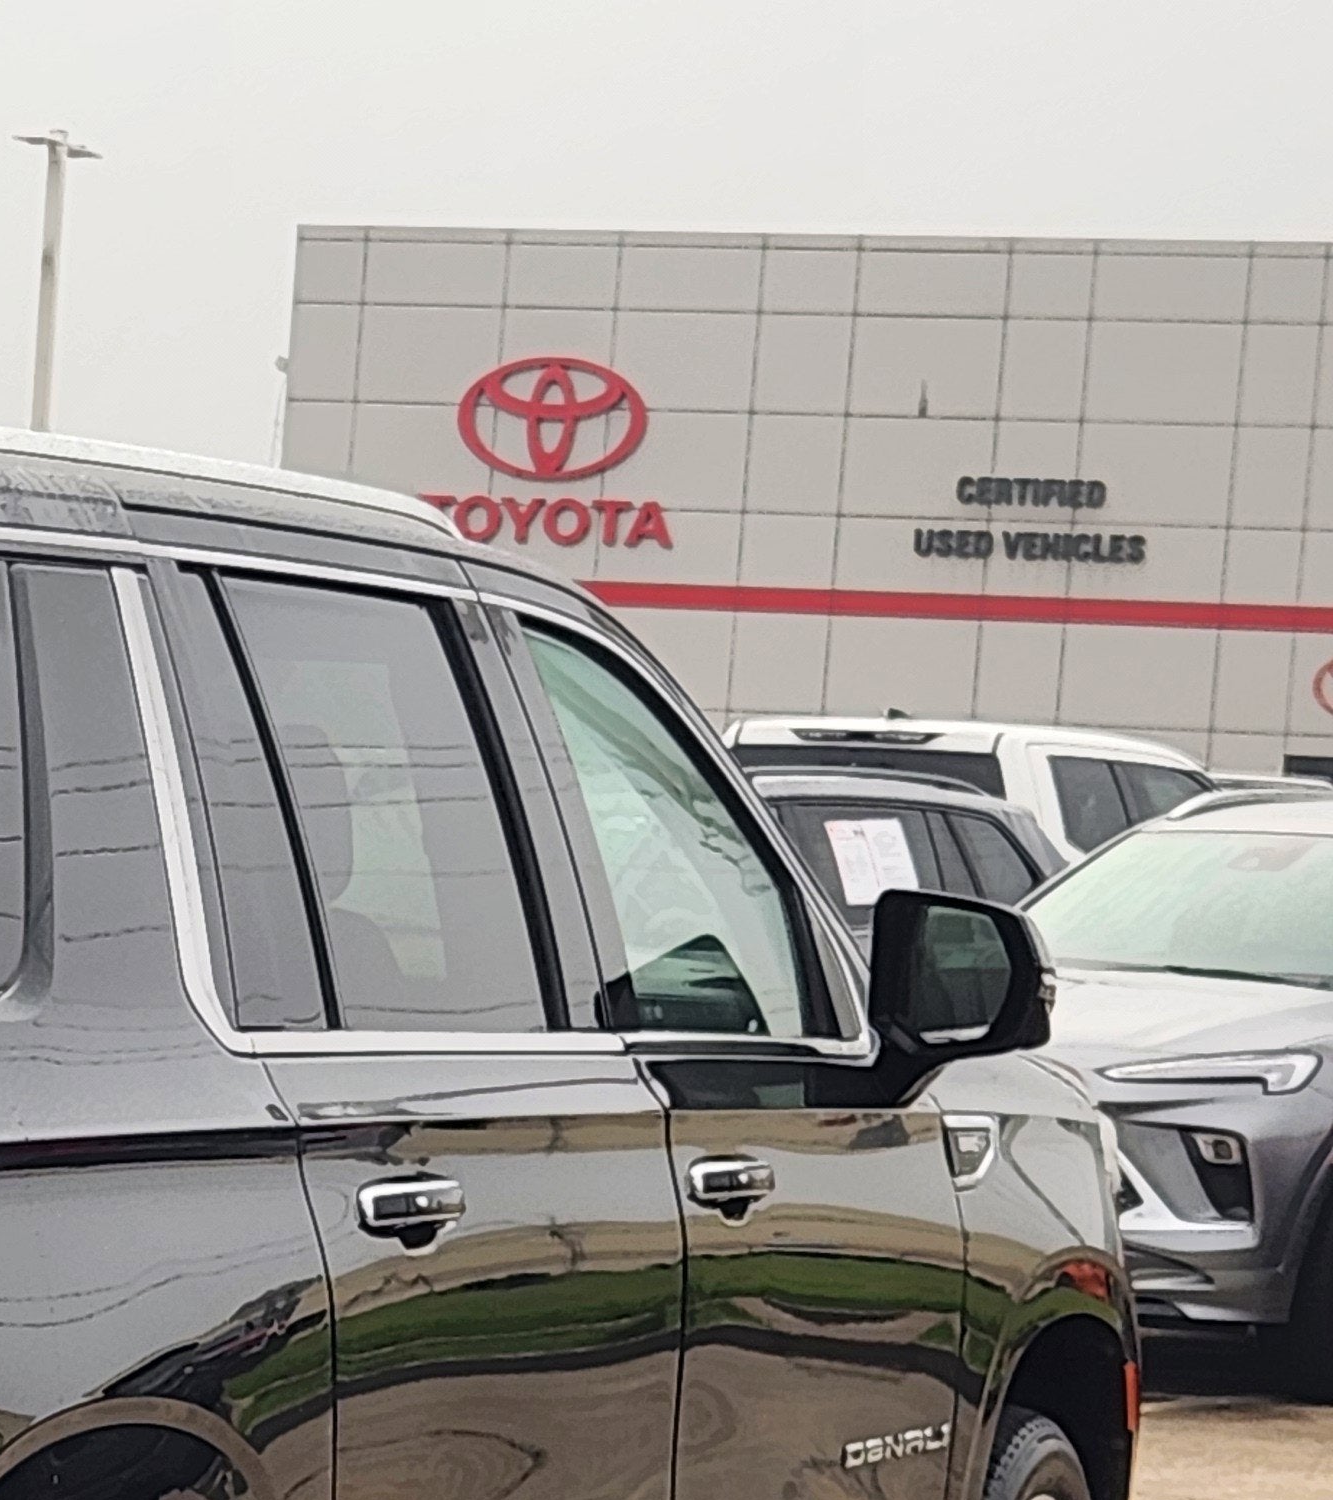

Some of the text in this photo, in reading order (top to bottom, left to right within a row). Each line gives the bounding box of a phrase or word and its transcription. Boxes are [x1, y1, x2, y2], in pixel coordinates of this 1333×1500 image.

[956, 475, 1106, 509] CERTIFIED
[913, 528, 1146, 564] USED VEHICLES
[843, 1422, 951, 1470] DENALI
